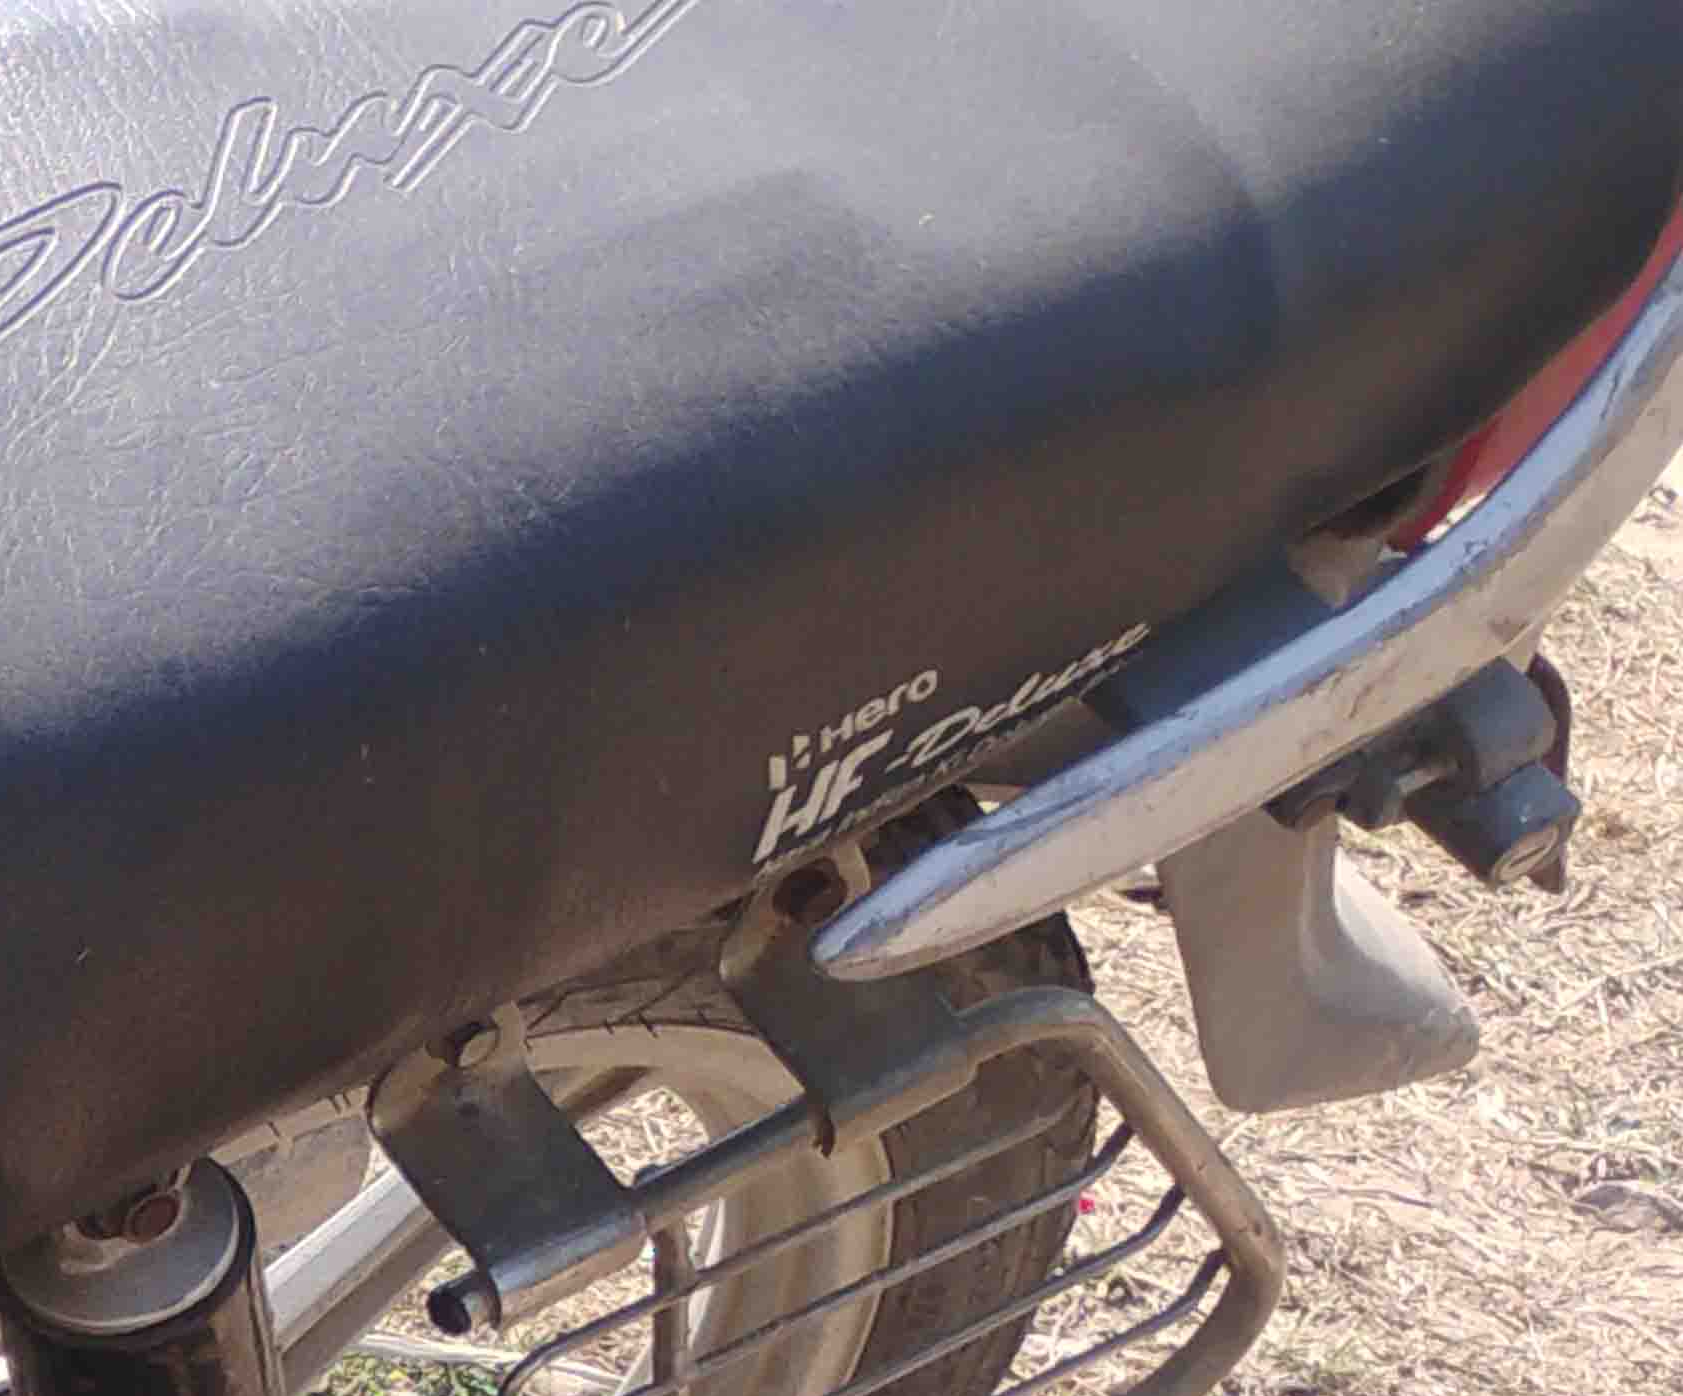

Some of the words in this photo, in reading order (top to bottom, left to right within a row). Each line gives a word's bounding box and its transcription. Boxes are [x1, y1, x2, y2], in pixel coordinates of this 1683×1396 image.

[752, 729, 893, 864] HF
[885, 621, 1151, 773] Deluxe
[818, 668, 939, 753] Hero
